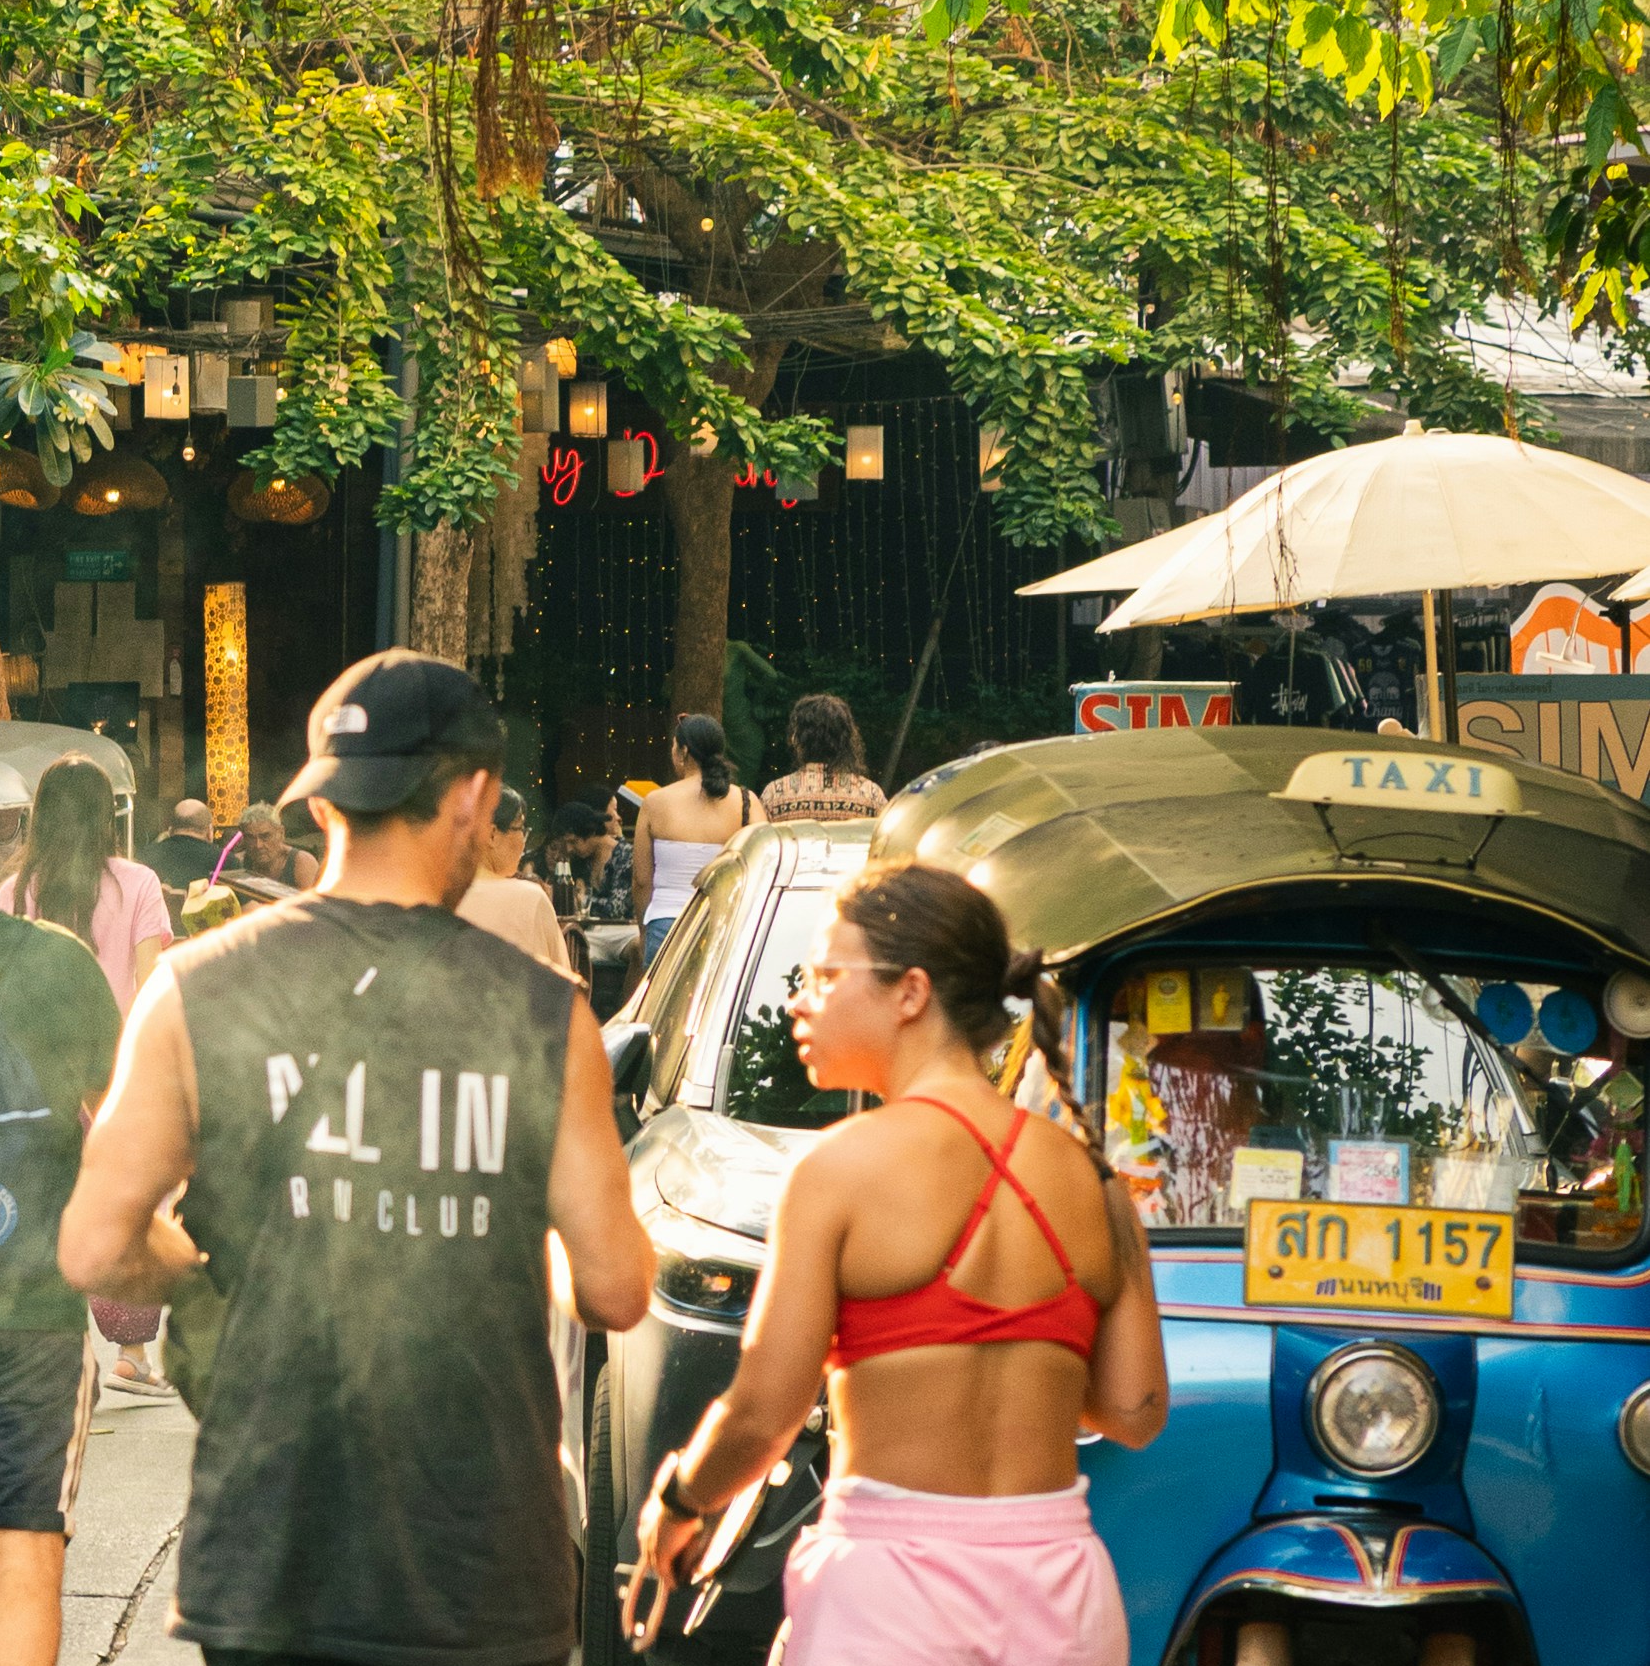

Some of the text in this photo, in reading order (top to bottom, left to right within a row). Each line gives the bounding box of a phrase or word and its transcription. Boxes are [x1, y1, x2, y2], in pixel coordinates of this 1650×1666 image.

[1343, 758, 1483, 797] TAXI
[377, 1189, 491, 1237] CLUB
[1276, 1210, 1503, 1269] สก 1157
